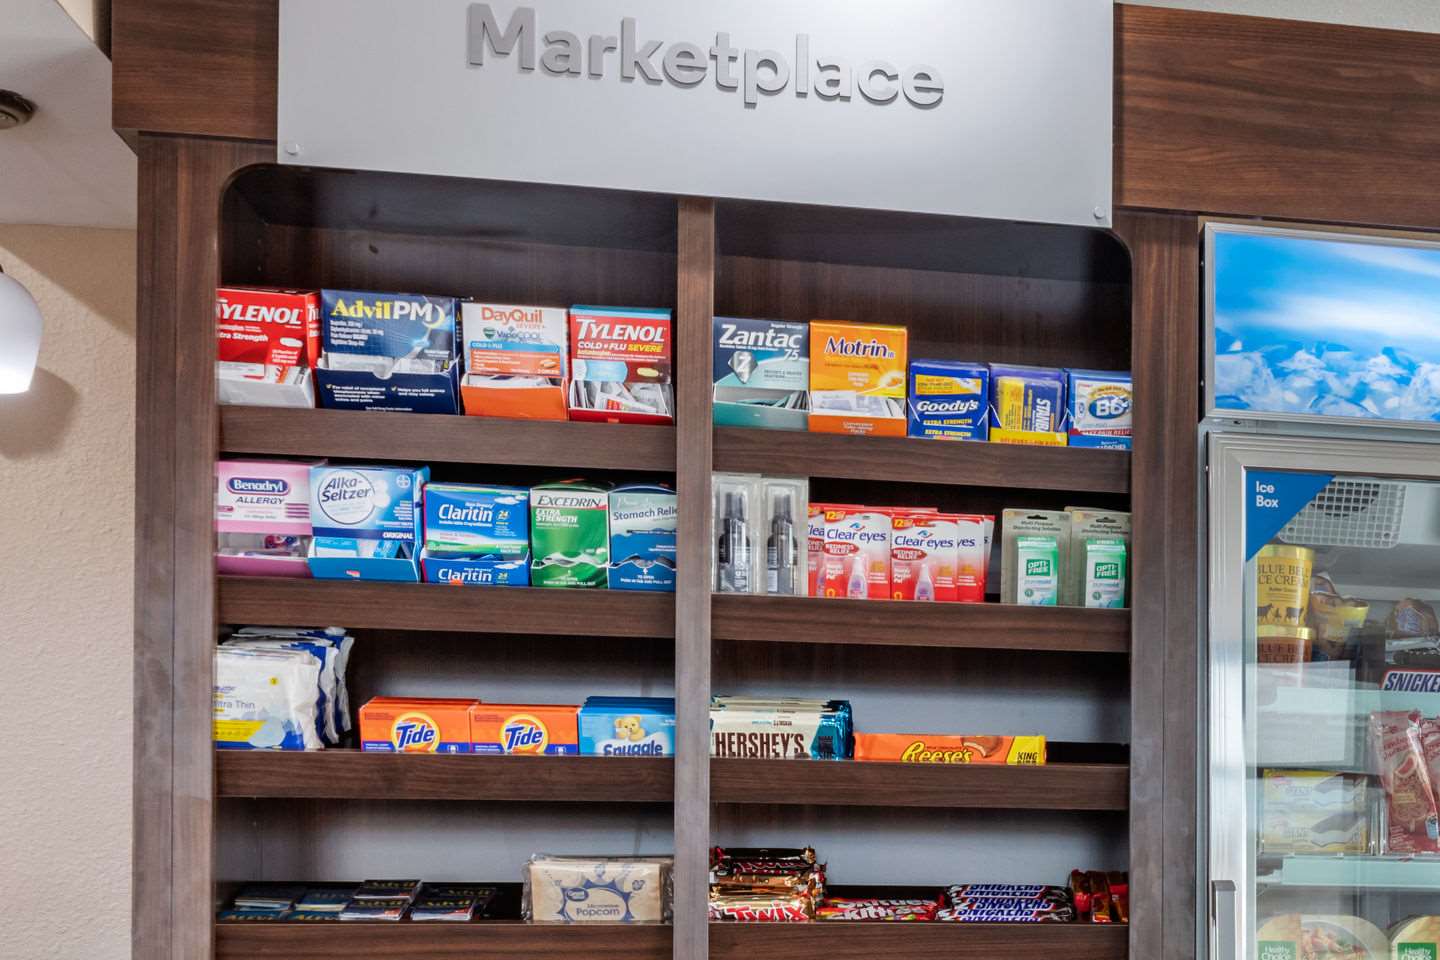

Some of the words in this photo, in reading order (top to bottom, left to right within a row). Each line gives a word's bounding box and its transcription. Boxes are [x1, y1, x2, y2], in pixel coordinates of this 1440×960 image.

[466, 2, 946, 109] Marketplace
[331, 298, 393, 320] Advil
[481, 306, 544, 327] DayQuil
[576, 319, 666, 343] TYLENOL
[719, 323, 803, 349] Zantac
[578, 341, 601, 350] COLD
[628, 343, 664, 353] SEVERE
[824, 336, 888, 358] Motrin
[783, 349, 800, 361] 75
[916, 399, 979, 415] Goody's
[233, 479, 284, 494] Benadryl
[325, 476, 364, 490] Alka-
[1255, 480, 1275, 494] Ice
[235, 496, 285, 505] ALLERGY
[321, 488, 372, 503] Seltzer
[537, 495, 602, 508] EXCEDRIN
[1255, 494, 1279, 508] Box
[438, 503, 493, 523] Claritin
[613, 508, 656, 521] Stomach
[826, 528, 858, 541] Clear
[859, 531, 888, 546] eyes
[894, 535, 925, 548] Clear
[927, 537, 954, 550] eyes
[438, 569, 493, 583] Claritin
[396, 724, 435, 747] Tide
[505, 725, 543, 749] Tide
[714, 731, 806, 758] HERSHEY'S
[901, 742, 972, 763] Reese's
[576, 907, 620, 917] Popcorn
